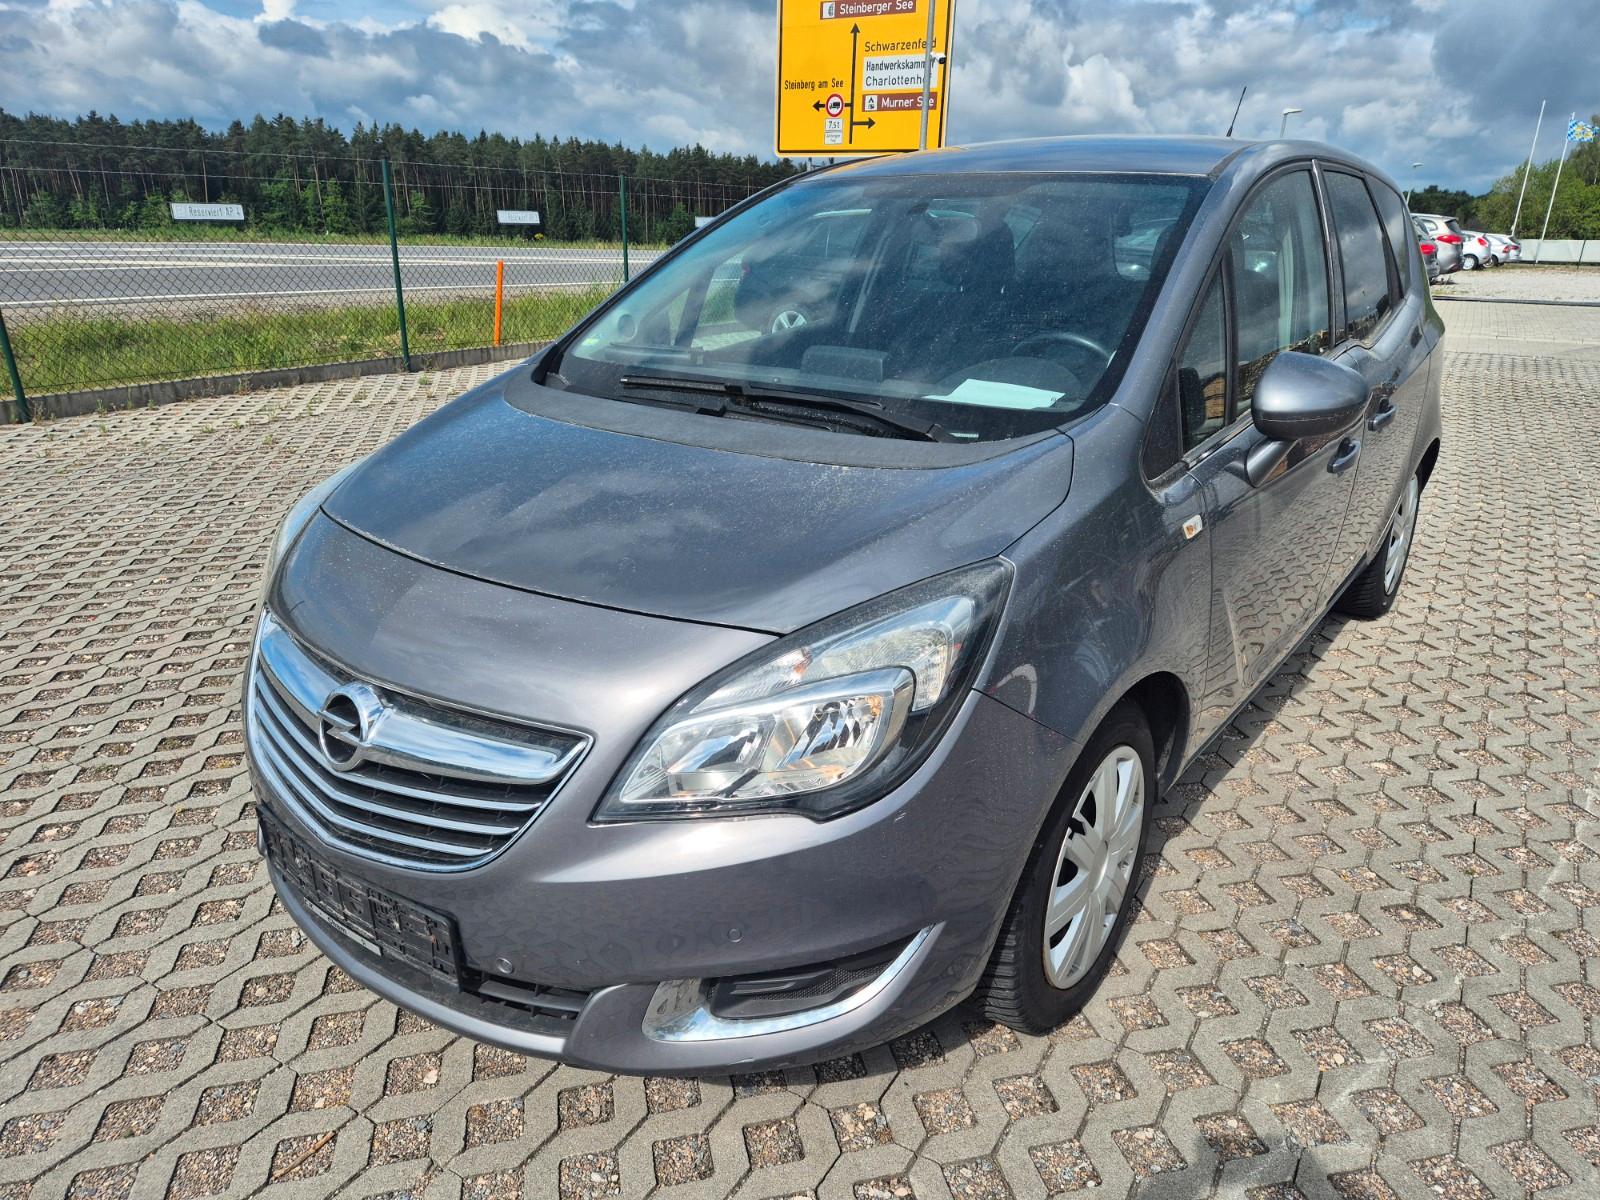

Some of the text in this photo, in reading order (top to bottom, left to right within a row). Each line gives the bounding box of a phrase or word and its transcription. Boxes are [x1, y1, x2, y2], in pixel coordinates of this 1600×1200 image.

[840, 0, 913, 14] Steinberger See
[864, 37, 936, 52] Schwarzenfed
[866, 59, 935, 71] Handwerkskammr
[784, 80, 815, 91] Steinberg
[832, 77, 843, 88] See
[865, 72, 932, 87] Charlottenh
[881, 96, 934, 108] Murner Se
